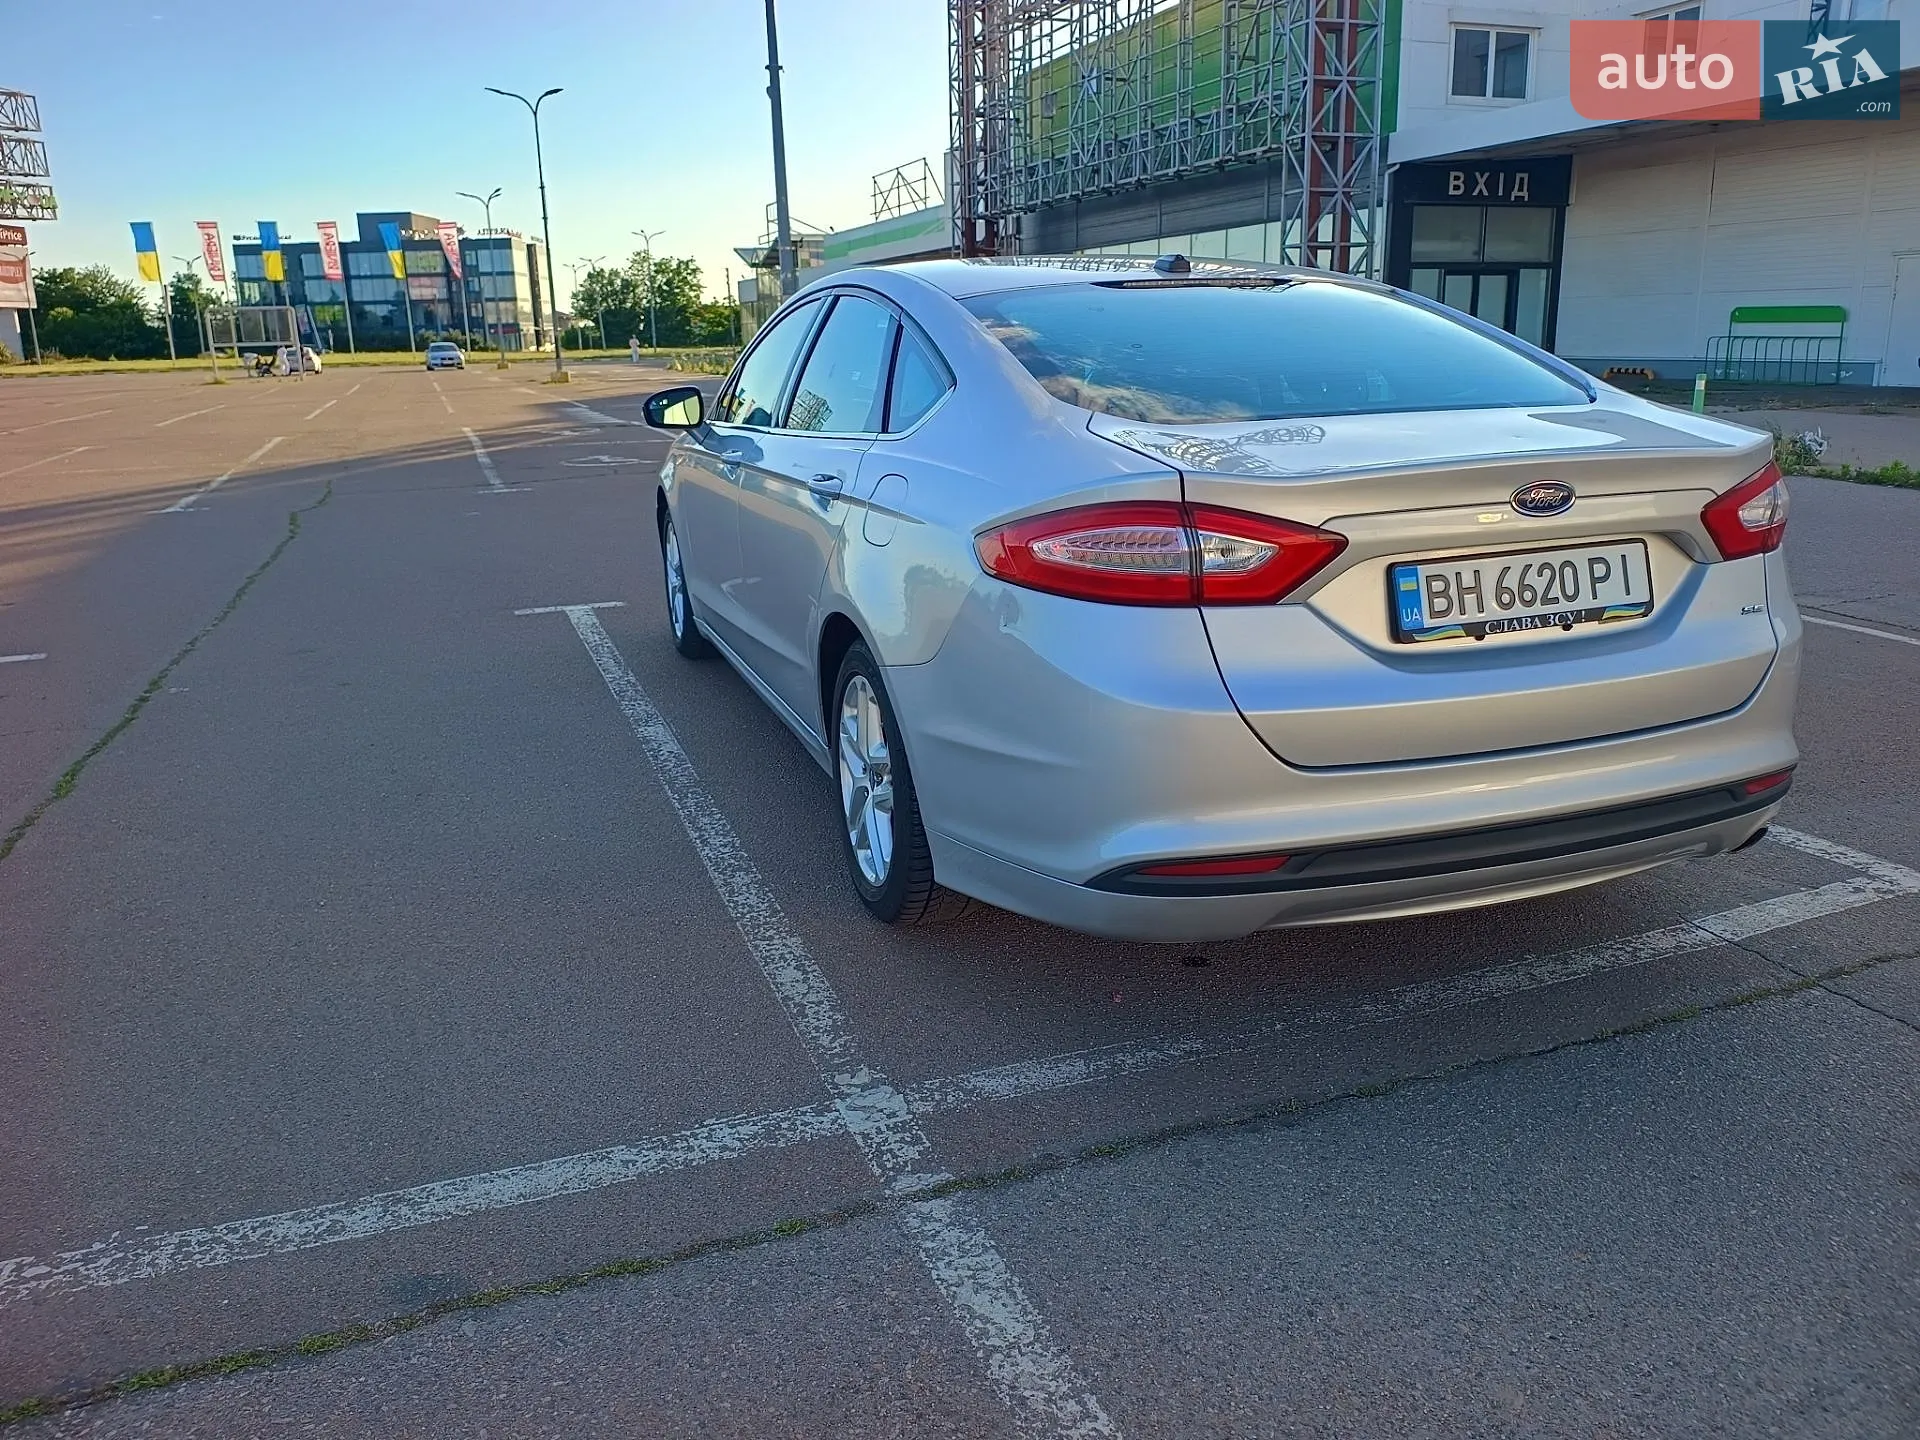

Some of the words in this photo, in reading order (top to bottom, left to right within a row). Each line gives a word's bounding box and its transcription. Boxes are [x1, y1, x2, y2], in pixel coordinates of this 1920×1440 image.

[1448, 171, 1529, 202] ВХІД
[1527, 488, 1563, 508] Ford
[1425, 569, 1485, 620] BH
[1494, 560, 1580, 611] 6620
[1587, 554, 1631, 600] PI
[1403, 608, 1422, 622] UA
[1484, 613, 1545, 635] СЛАВА
[1546, 611, 1577, 627] ЗСУ
